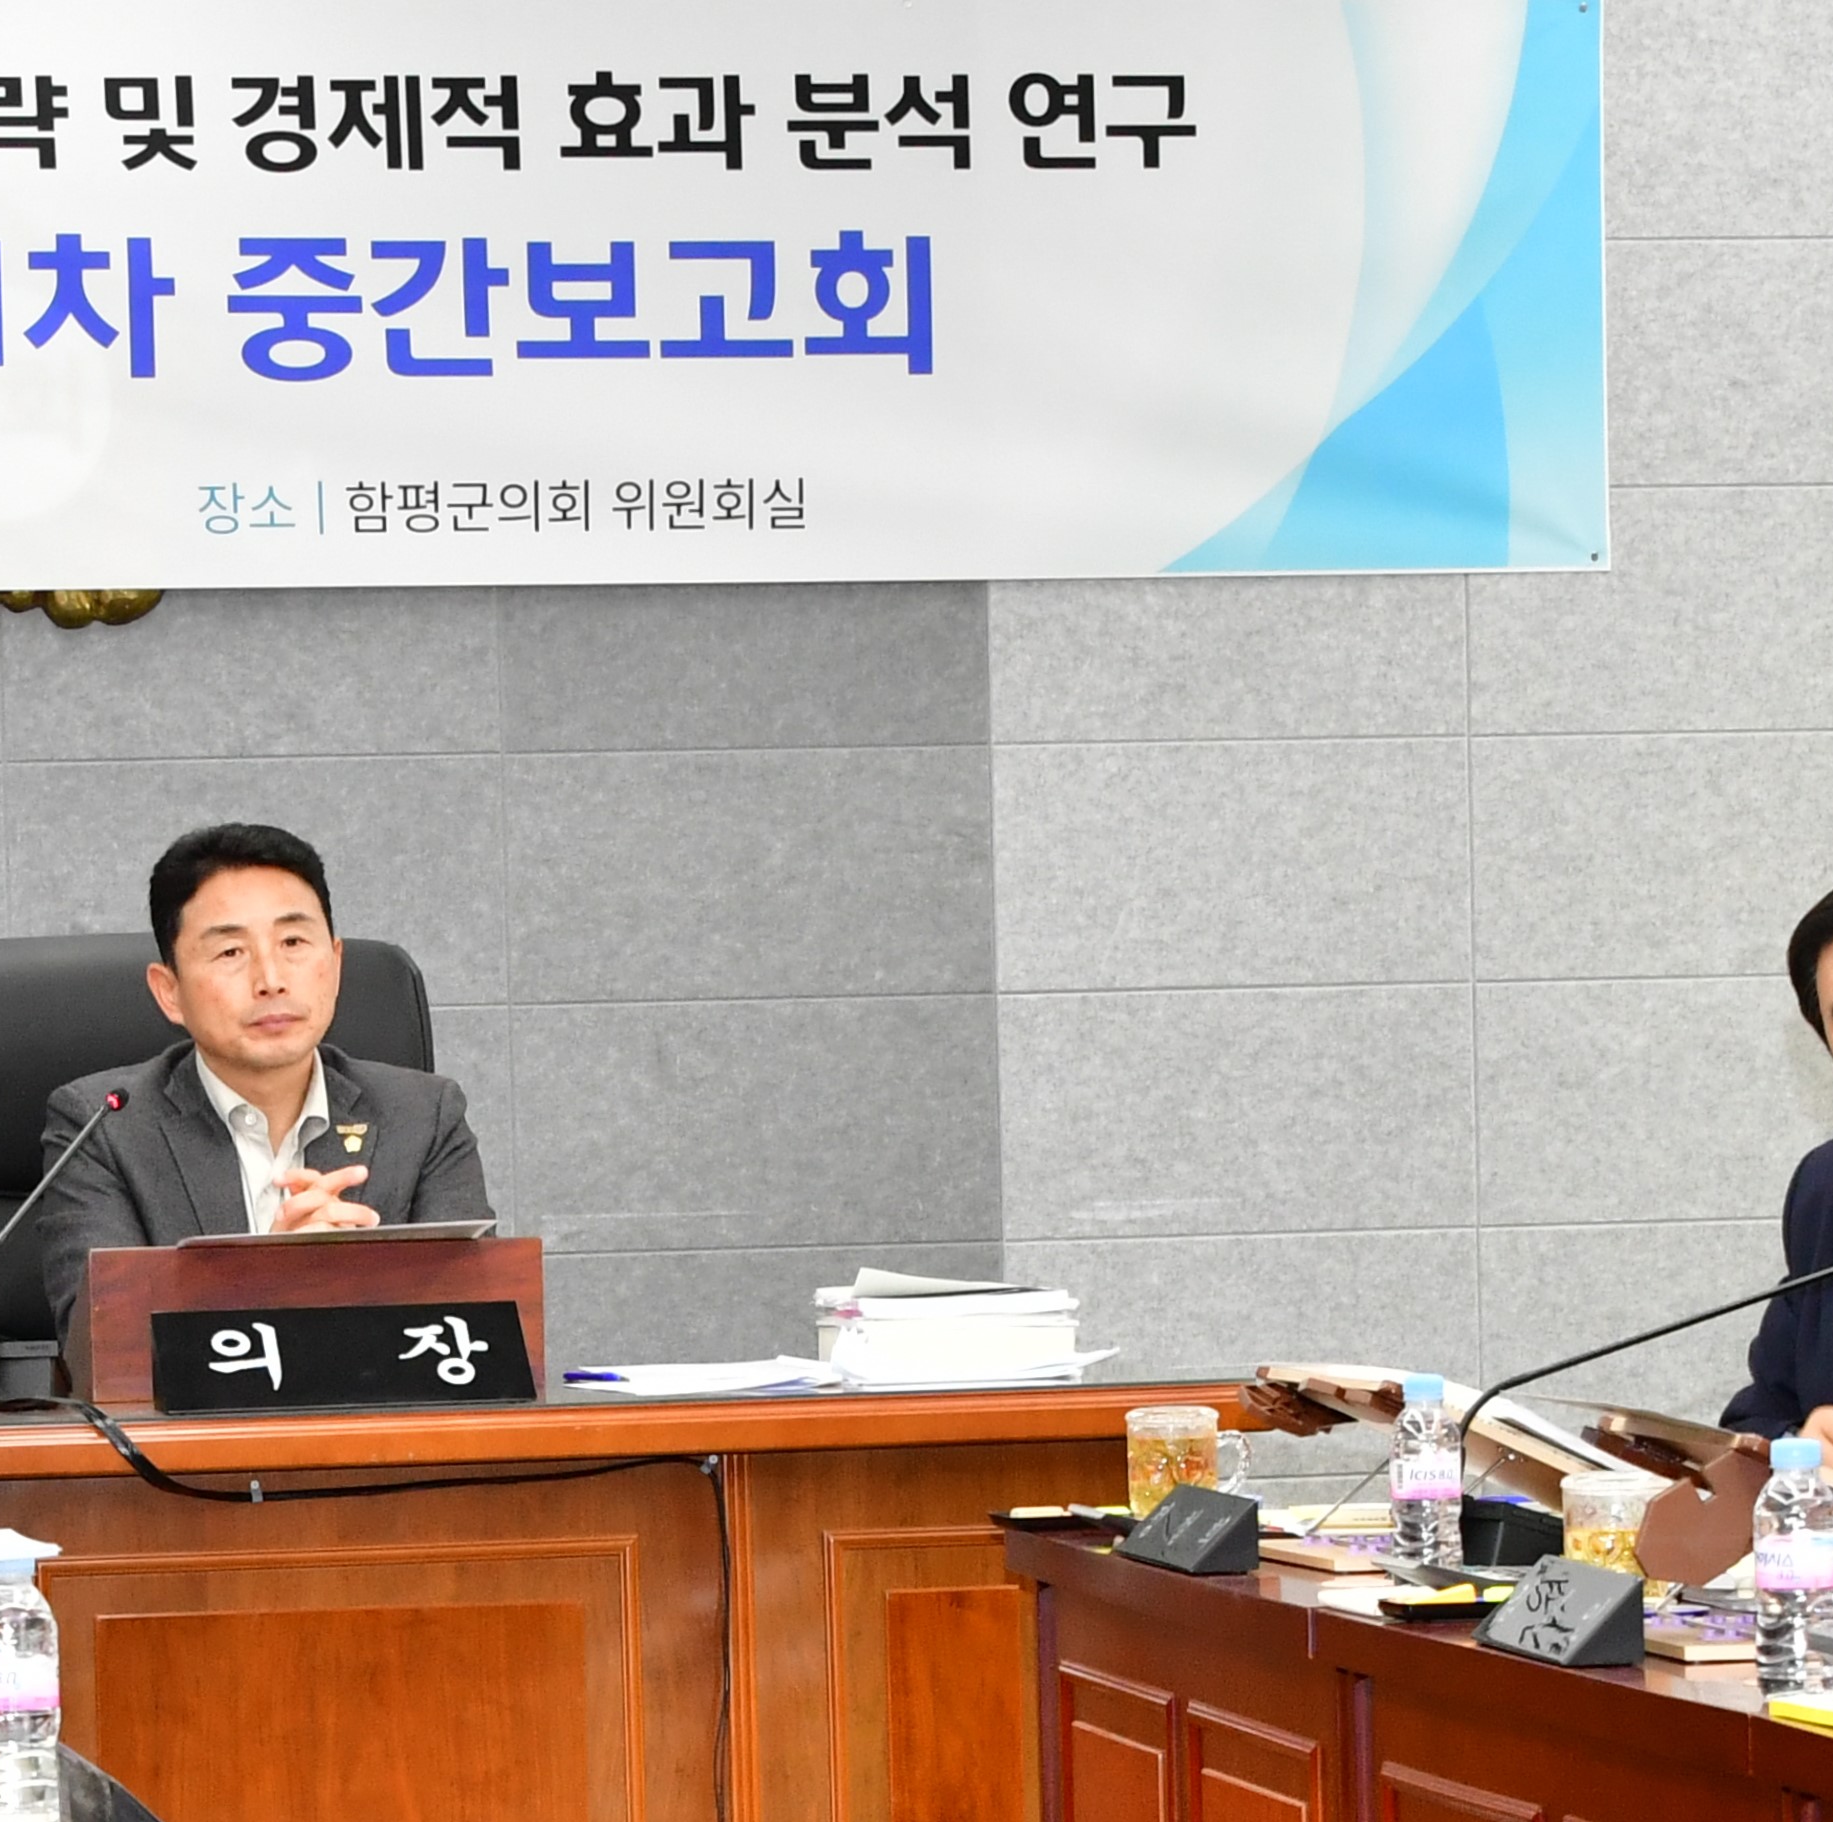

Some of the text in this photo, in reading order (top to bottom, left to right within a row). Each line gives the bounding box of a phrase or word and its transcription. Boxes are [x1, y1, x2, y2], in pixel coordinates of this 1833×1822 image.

[105, 76, 196, 171] 및
[232, 76, 520, 172] 경제적
[561, 71, 755, 169] 효과
[788, 74, 970, 169] 분석
[1009, 73, 1196, 168] 연구
[228, 230, 932, 382] 중간보고회
[199, 478, 805, 535] 장소 함평군의회 위원회실
